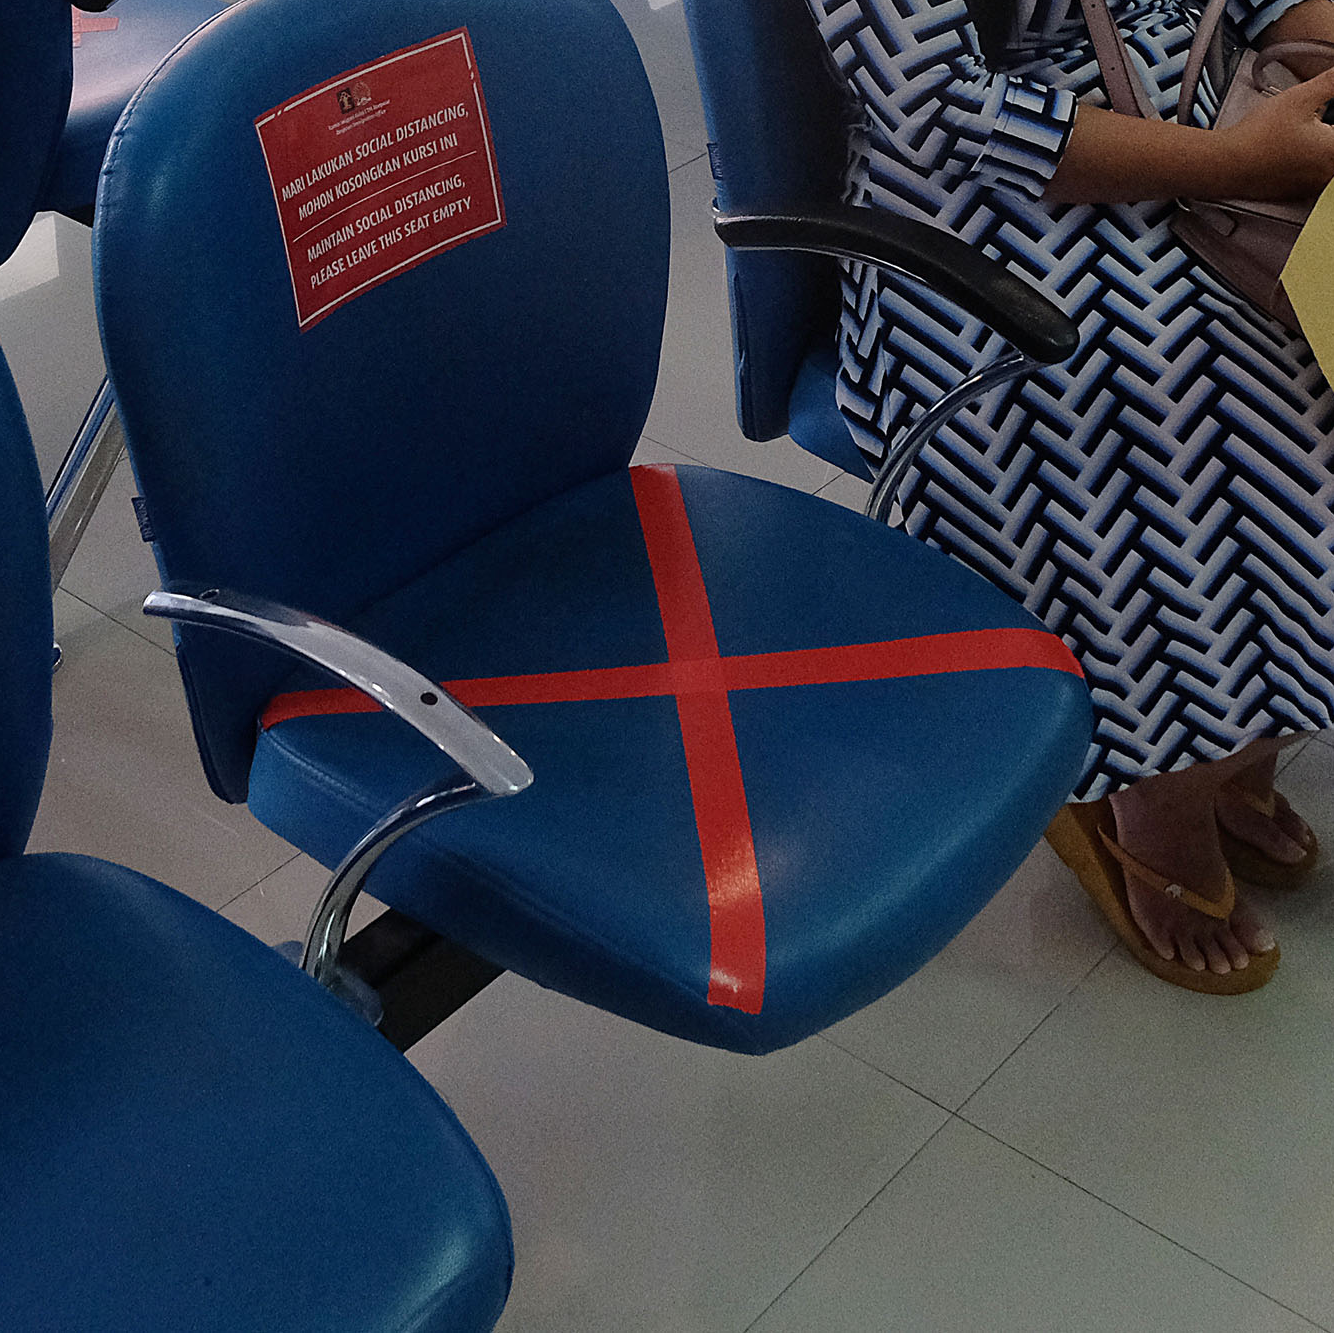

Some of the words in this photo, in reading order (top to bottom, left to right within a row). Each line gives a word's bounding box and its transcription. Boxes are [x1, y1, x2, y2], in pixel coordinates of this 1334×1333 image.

[281, 176, 306, 202] MARI
[305, 152, 354, 187] LAKUKAN
[355, 132, 394, 161] SOCIAL
[395, 102, 469, 143] DISTANCING,
[298, 189, 334, 221] MOHON
[335, 159, 401, 200] KOSONGKAN
[402, 143, 438, 166] KURSI
[440, 133, 458, 151] INI
[307, 224, 355, 263] MAINTAIN
[355, 205, 394, 234] SOCIAL
[394, 174, 466, 214] DISTANCING,
[310, 258, 346, 290] PLEASE
[346, 240, 378, 268] LEAVE
[378, 227, 403, 250] THIS
[404, 214, 430, 237] SEAT
[432, 196, 472, 224] EMPTY
